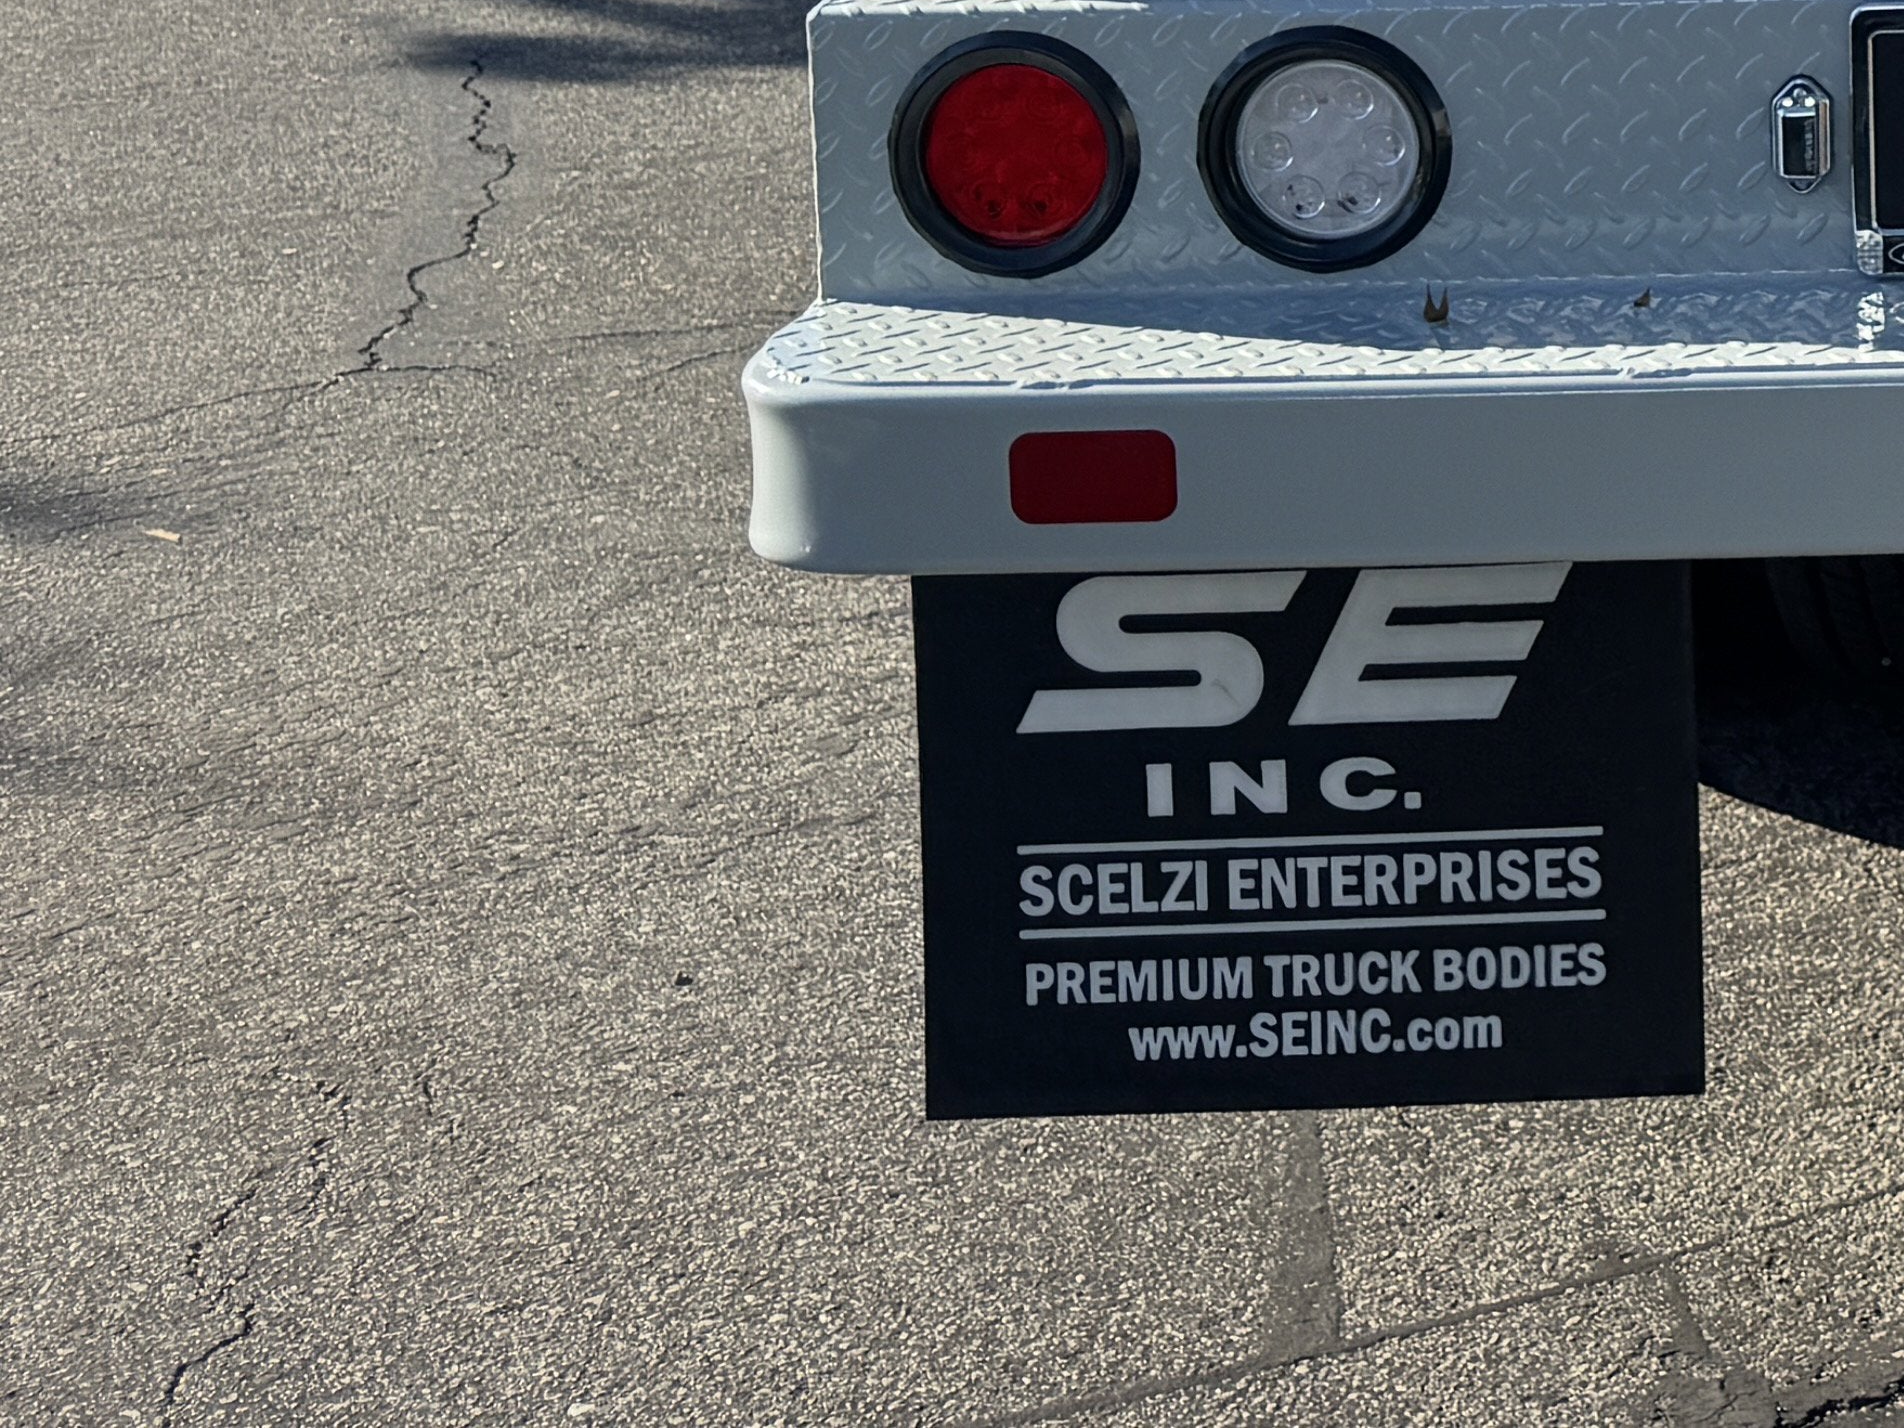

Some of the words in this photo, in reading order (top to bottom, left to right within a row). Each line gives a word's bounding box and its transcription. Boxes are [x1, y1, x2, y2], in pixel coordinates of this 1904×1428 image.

[1015, 561, 1573, 734] SE
[1145, 756, 1422, 818] INC.
[1018, 859, 1210, 918] SCELZI
[1228, 846, 1602, 912] ENTERPRISES
[1025, 954, 1254, 1007] PREMIUM
[1262, 948, 1423, 998] TRUCK
[1432, 942, 1608, 994] BODIES
[1128, 1009, 1503, 1062] www.SEINC.com
